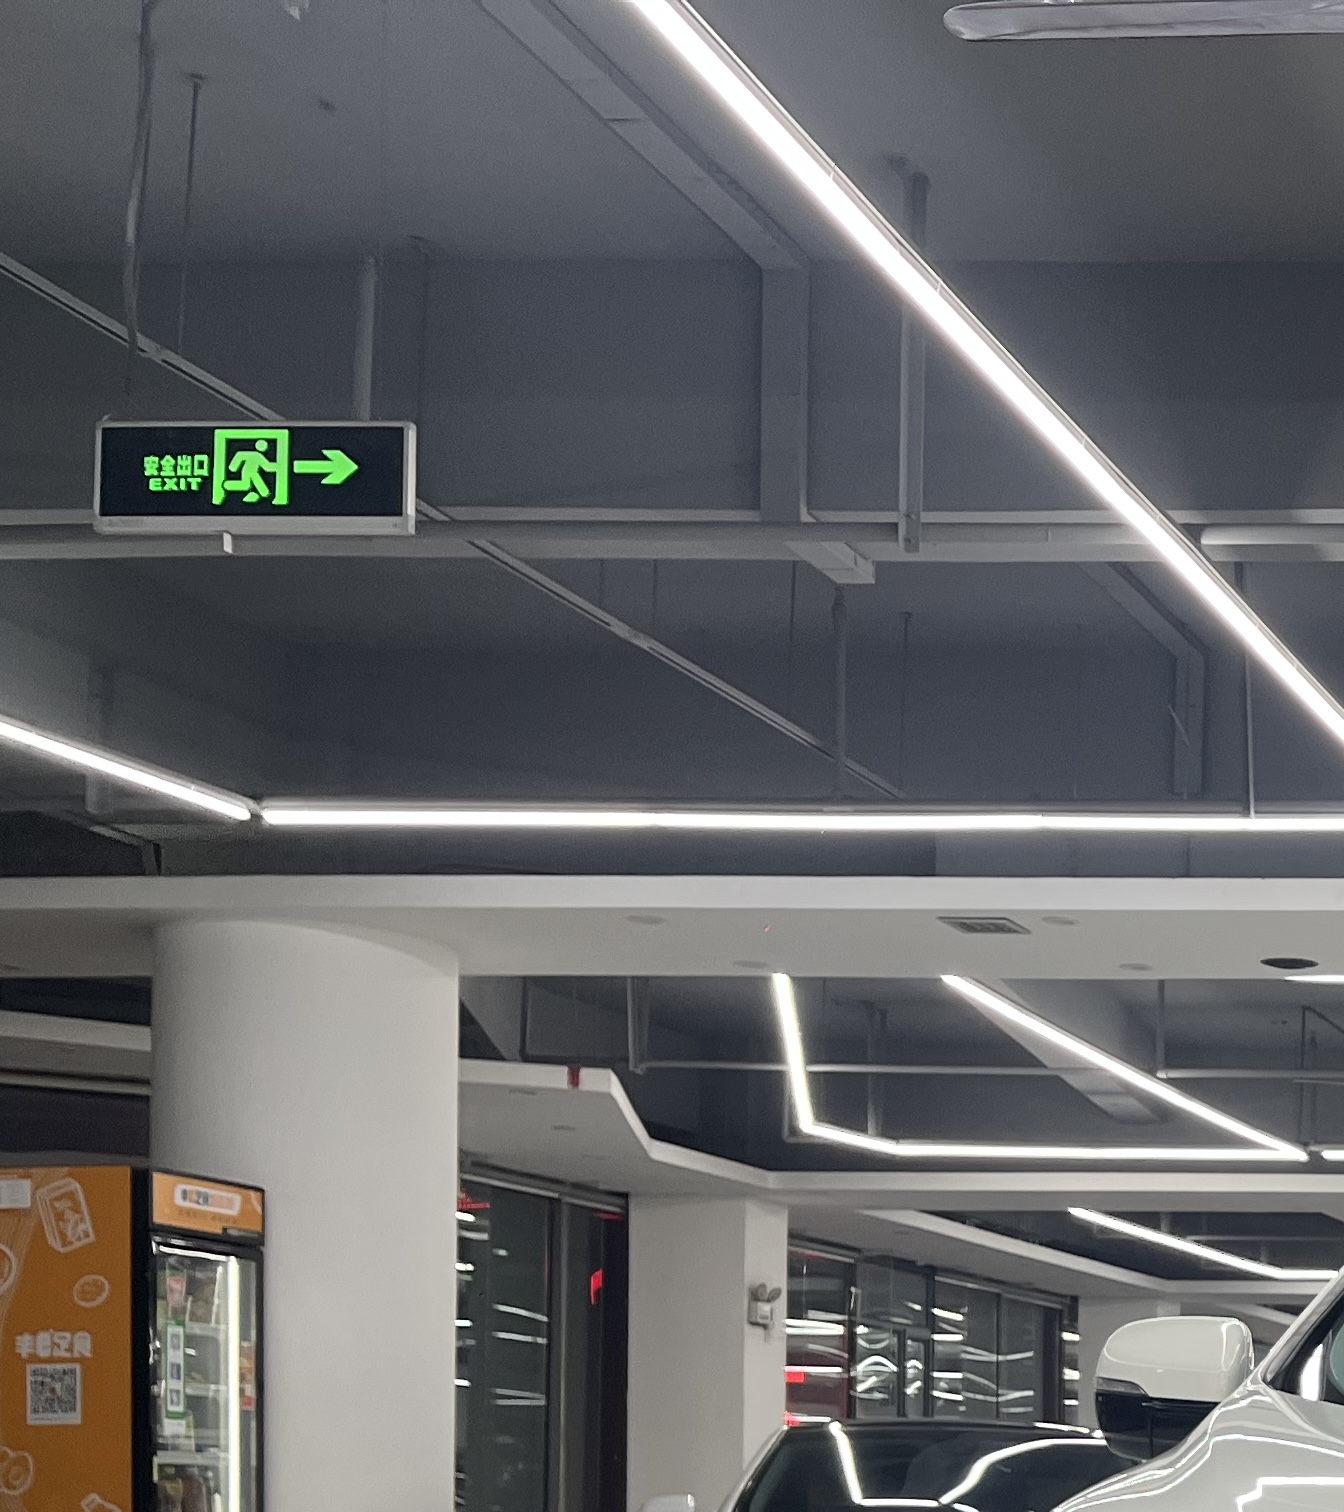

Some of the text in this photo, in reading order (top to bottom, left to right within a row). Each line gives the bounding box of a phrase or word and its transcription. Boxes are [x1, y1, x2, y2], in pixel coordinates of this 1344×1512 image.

[143, 454, 209, 477] 安全出口
[148, 477, 203, 491] EXIT
